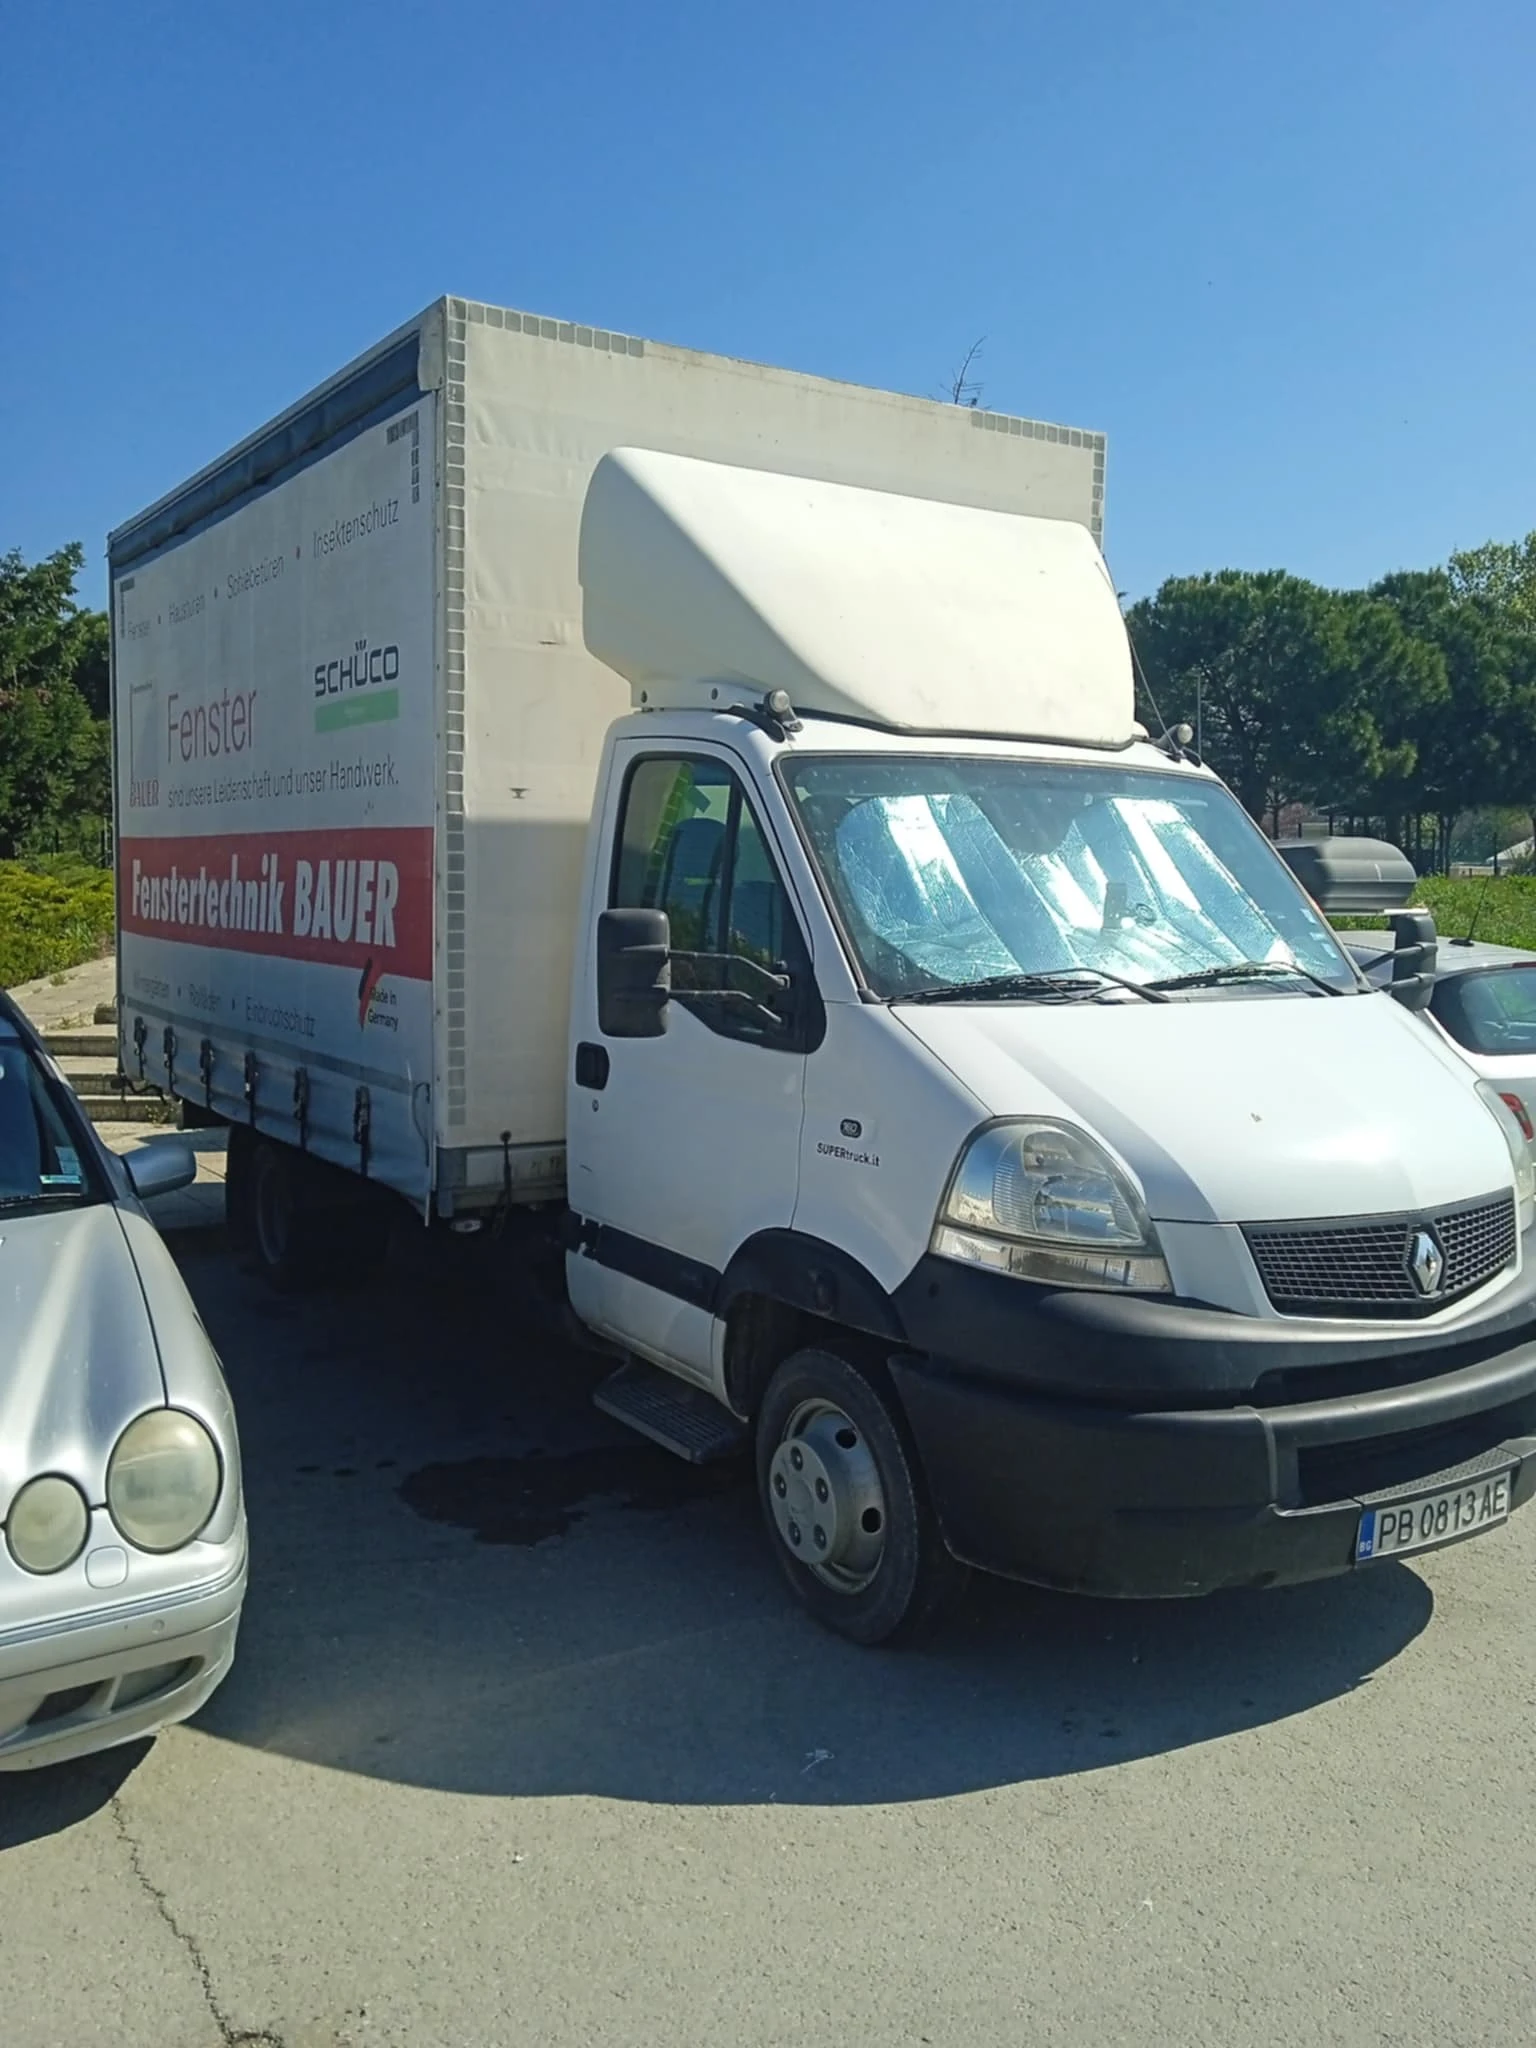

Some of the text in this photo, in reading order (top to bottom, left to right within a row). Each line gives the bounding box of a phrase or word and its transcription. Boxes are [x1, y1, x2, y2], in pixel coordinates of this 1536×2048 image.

[312, 499, 400, 559] Insektenschutz
[314, 639, 399, 698] SCHÜCO
[167, 686, 257, 764] Fenster
[213, 768, 271, 804] Leidenschaft
[272, 767, 293, 798] und
[295, 768, 327, 796] unser
[329, 752, 399, 791] Handwerk.
[132, 854, 399, 948] Fenstertechnik BAUER
[367, 1006, 399, 1033] Germany
[816, 1141, 880, 1167] SUPERtruck.it
[1378, 1479, 1507, 1550] PB 0813 AE
